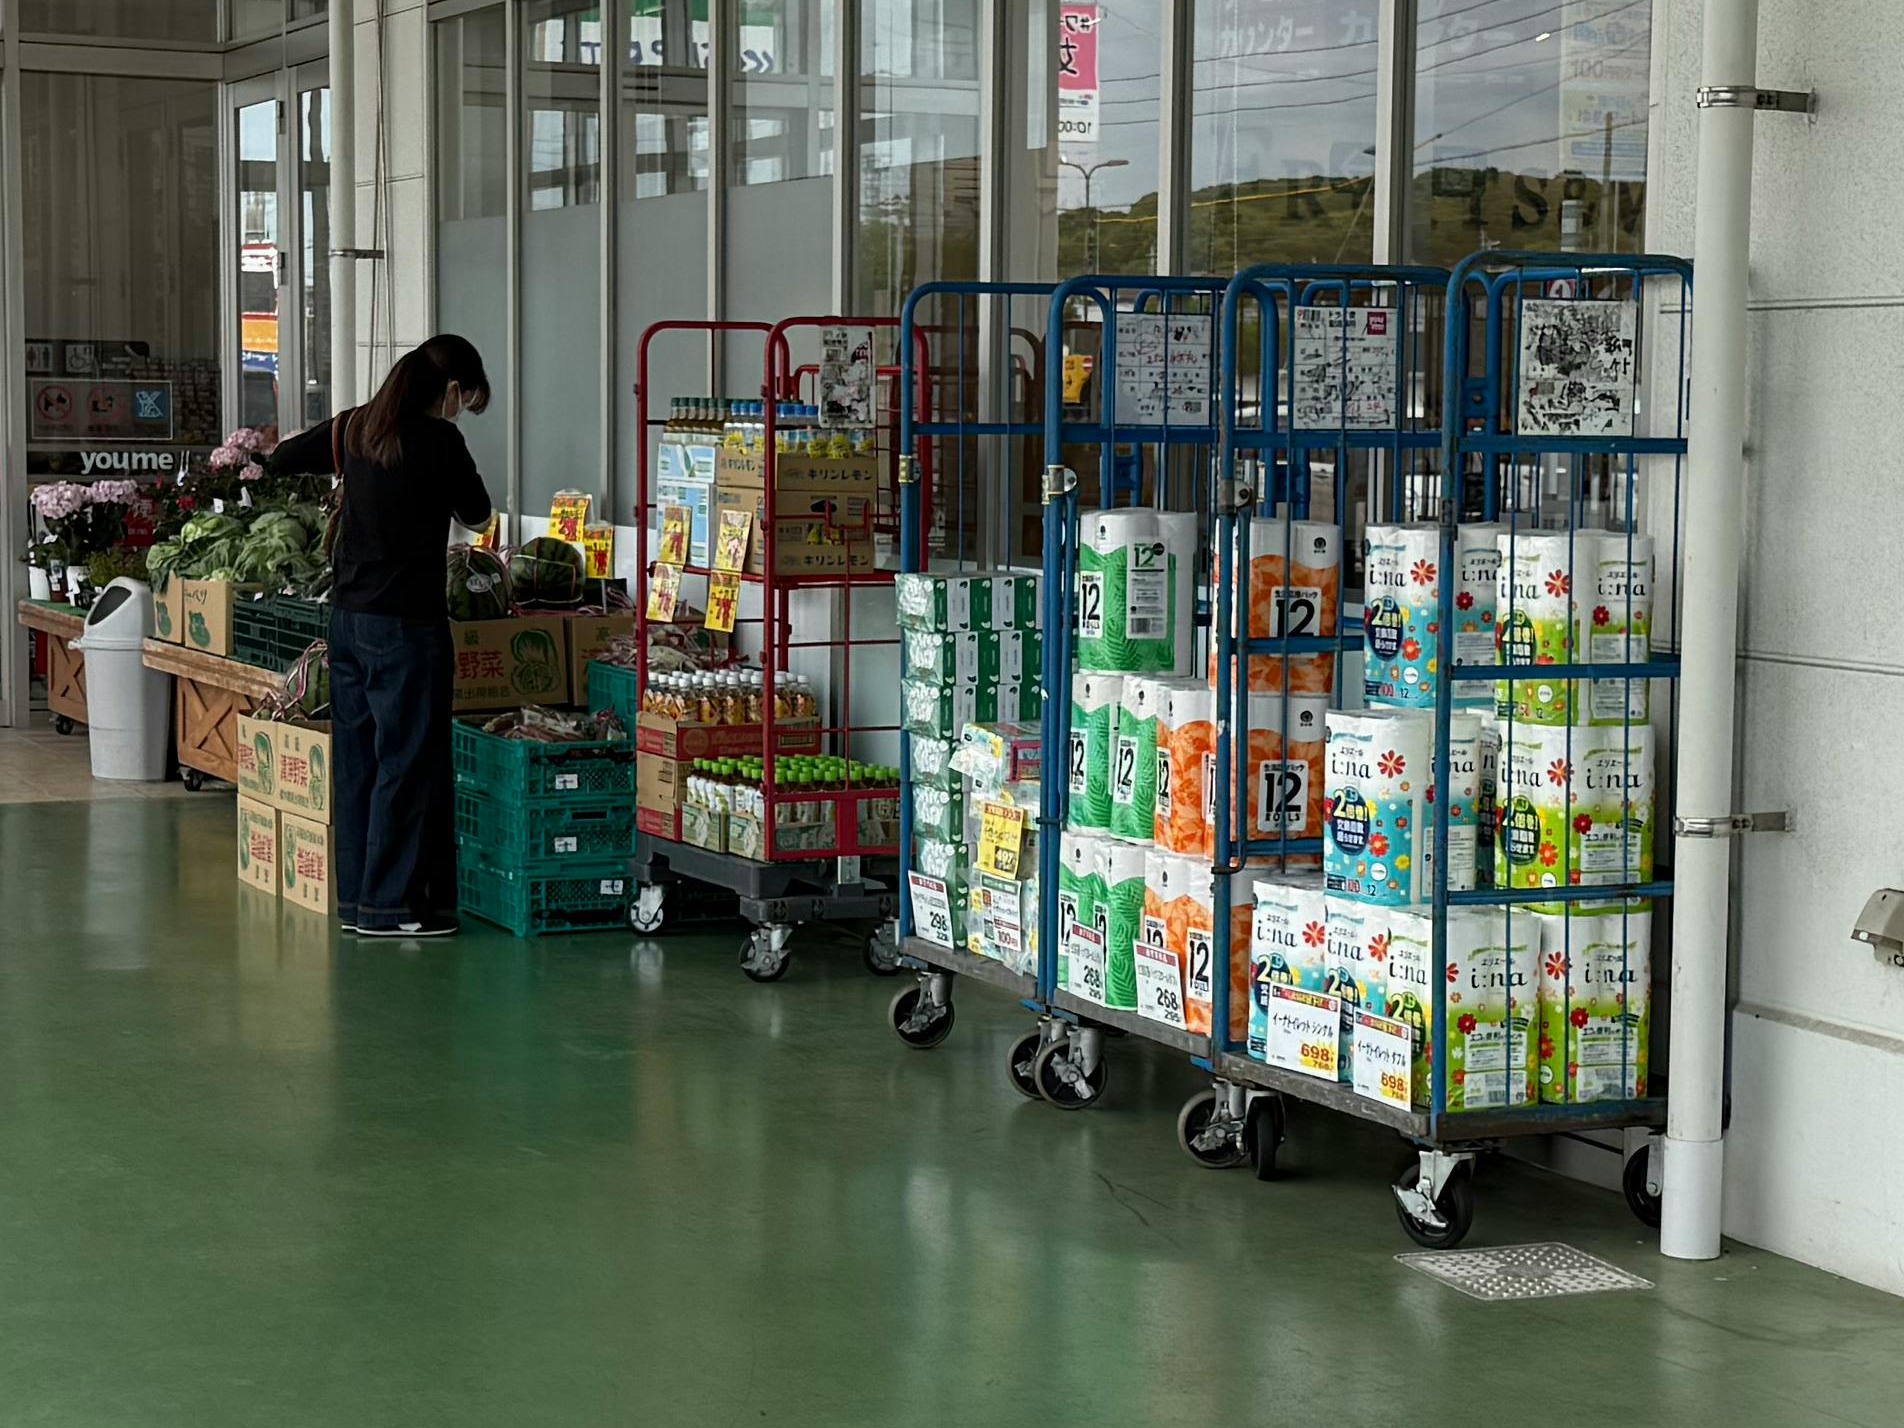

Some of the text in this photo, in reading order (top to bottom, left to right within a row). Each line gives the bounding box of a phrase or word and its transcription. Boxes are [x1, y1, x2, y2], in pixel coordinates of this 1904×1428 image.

[81, 451, 173, 475] youme
[808, 469, 872, 481] キリンレモン
[803, 555, 869, 566] キリンレモン
[1134, 546, 1154, 567] 12
[1369, 564, 1407, 587] i:na
[1501, 577, 1542, 600] ina
[1082, 582, 1101, 620] 12
[1277, 599, 1315, 636] 12
[457, 650, 505, 680] 野菜
[1118, 747, 1135, 786] 12
[1332, 753, 1373, 779] i:na
[1586, 768, 1644, 789] i:na
[1265, 772, 1302, 812] 12
[1265, 812, 1301, 822] ROLS
[1257, 919, 1298, 948] i:na
[1189, 940, 1209, 987] 12
[1389, 955, 1429, 986] i:na
[1585, 963, 1639, 984] i:na
[1471, 968, 1528, 989] i:na
[1156, 986, 1178, 1011] 268
[1301, 1043, 1330, 1063] 698
[1381, 1072, 1404, 1092] 698
